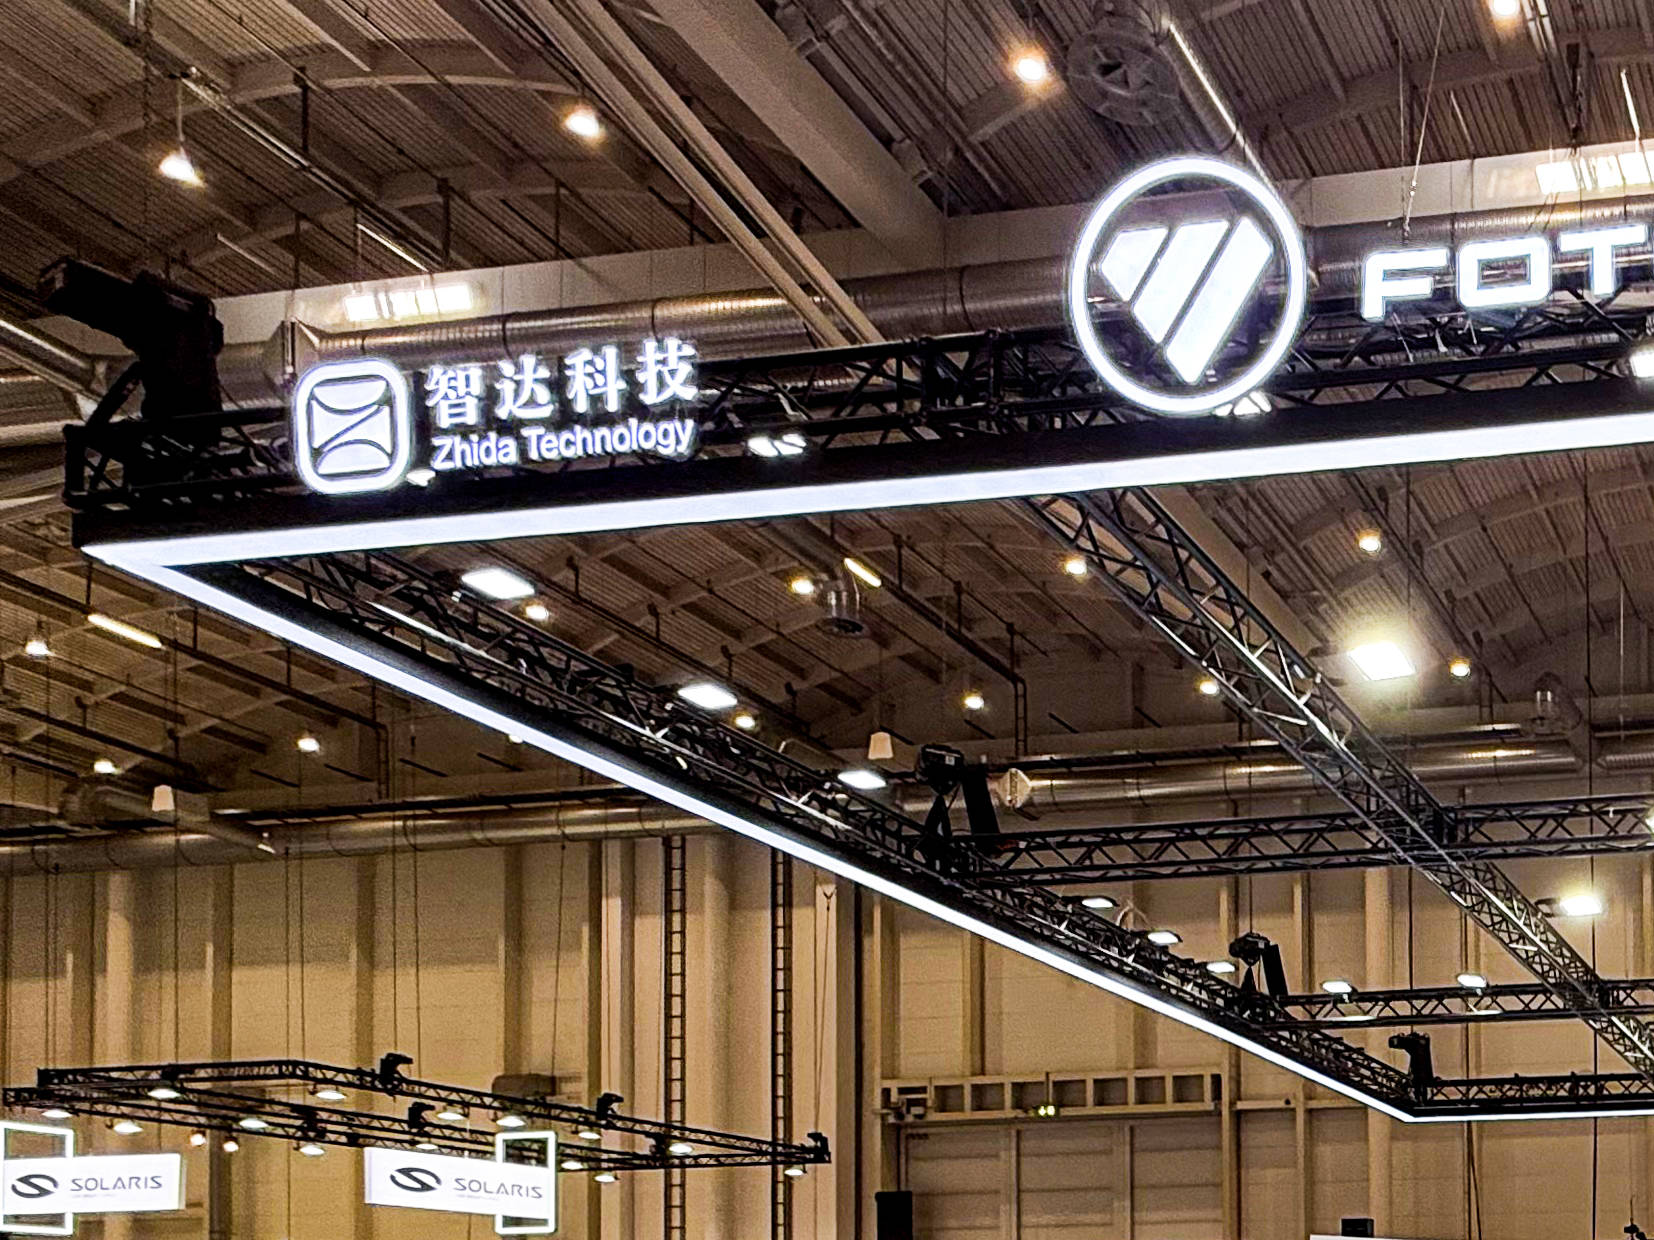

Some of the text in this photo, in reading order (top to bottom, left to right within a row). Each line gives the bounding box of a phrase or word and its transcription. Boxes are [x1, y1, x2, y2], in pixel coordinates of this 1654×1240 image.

[425, 338, 698, 428] 智达科技
[430, 418, 695, 470] Zhida Technology
[70, 1174, 163, 1192] SOLARIS
[454, 1176, 543, 1200] SOLARIS
